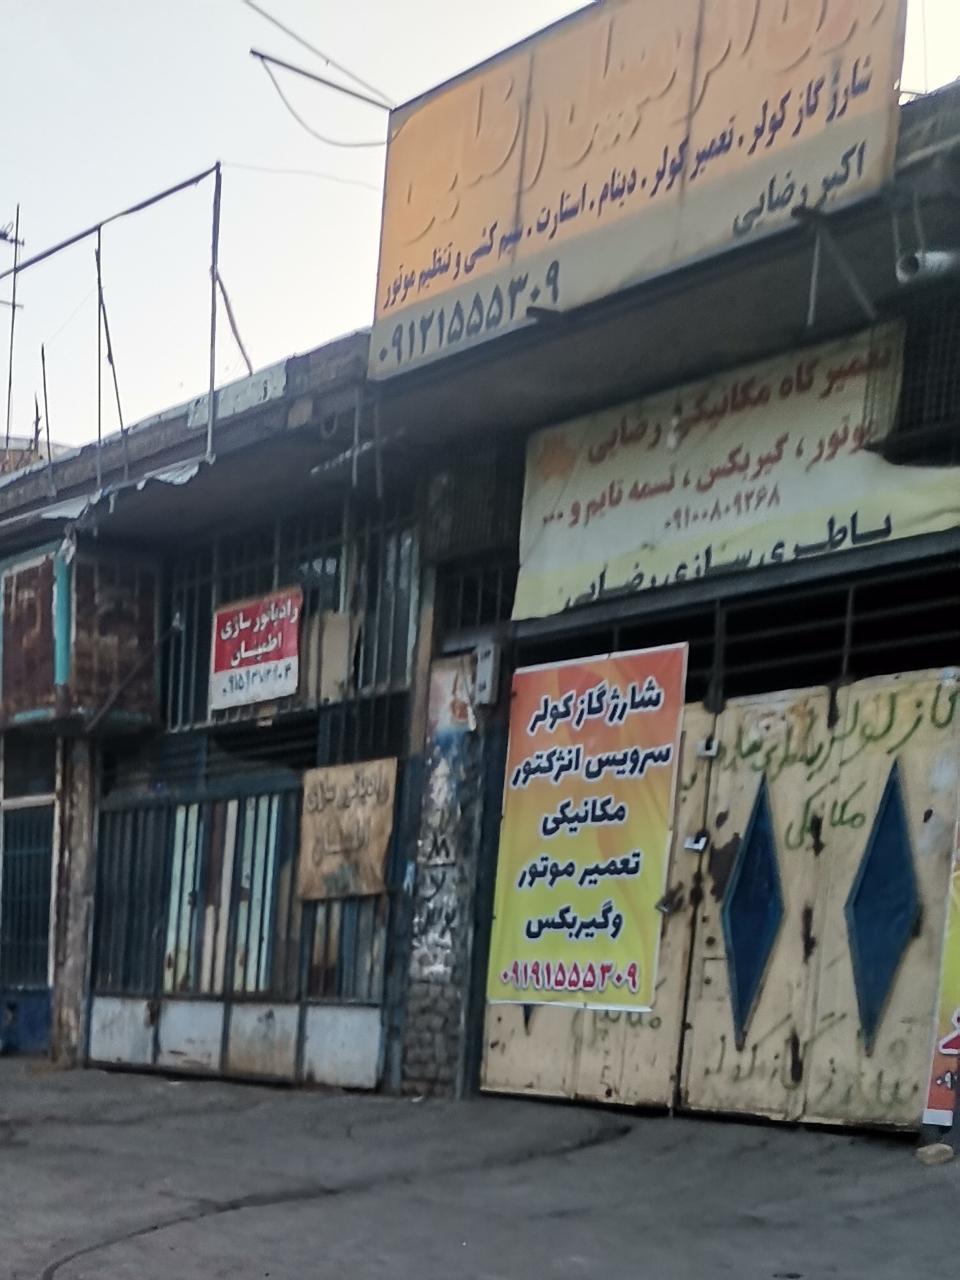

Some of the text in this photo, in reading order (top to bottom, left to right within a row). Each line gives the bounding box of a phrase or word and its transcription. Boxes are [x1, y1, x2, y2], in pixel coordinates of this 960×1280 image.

[792, 76, 825, 137] گاز
[826, 55, 873, 122] شارژ
[690, 114, 736, 181] تعمیر
[747, 89, 791, 155] کولر
[597, 166, 637, 218] دینام
[649, 135, 689, 197] کولر
[816, 139, 867, 209] اکبر
[536, 182, 588, 240] استارت
[417, 242, 454, 293] تنظیم
[452, 250, 462, 280] و
[464, 220, 498, 274] کشی
[378, 259, 561, 364] ۰۹۱۲۱۵۵۵۳۰۹
[383, 264, 416, 310] موتور
[220, 598, 299, 641] رادیاتور سازی
[529, 678, 662, 734] شارژ گاز کولر
[511, 745, 672, 786] سرویس انژکتور
[541, 796, 627, 836] مکانیکی
[517, 851, 641, 889] تعمیر موتور
[501, 959, 639, 991] ۰۹۱۹۱۵۵۵۳۰۹
